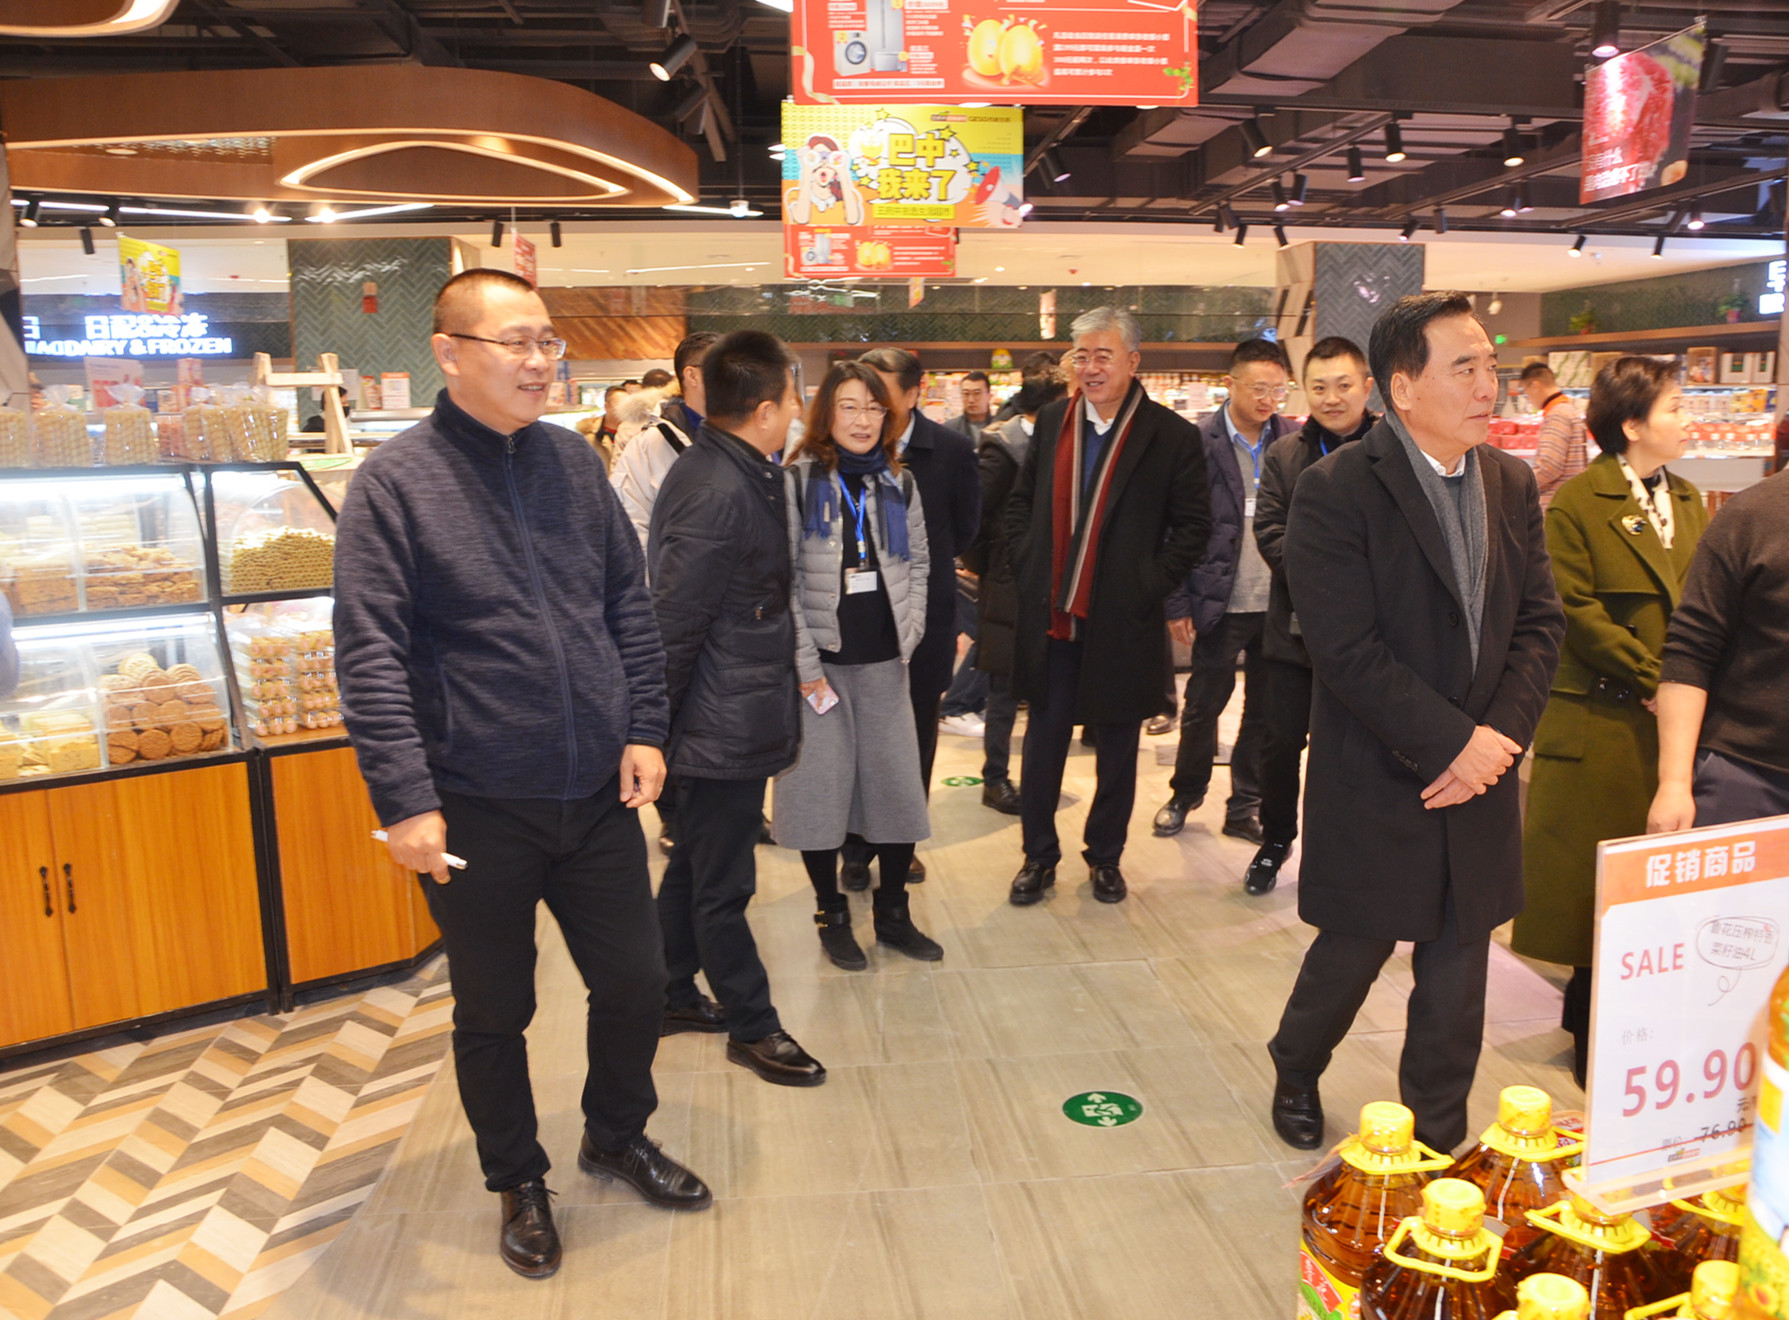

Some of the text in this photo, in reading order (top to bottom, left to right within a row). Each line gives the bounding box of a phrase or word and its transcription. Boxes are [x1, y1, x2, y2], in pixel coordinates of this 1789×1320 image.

[888, 133, 945, 167] 巴中
[877, 168, 956, 201] 我来了
[64, 339, 128, 357] DAIRY
[129, 337, 148, 355] &
[147, 337, 233, 355] FROZEN
[1646, 841, 1756, 888] 促销商品
[1620, 942, 1685, 980] SALE
[1622, 1042, 1757, 1117] 59.90
